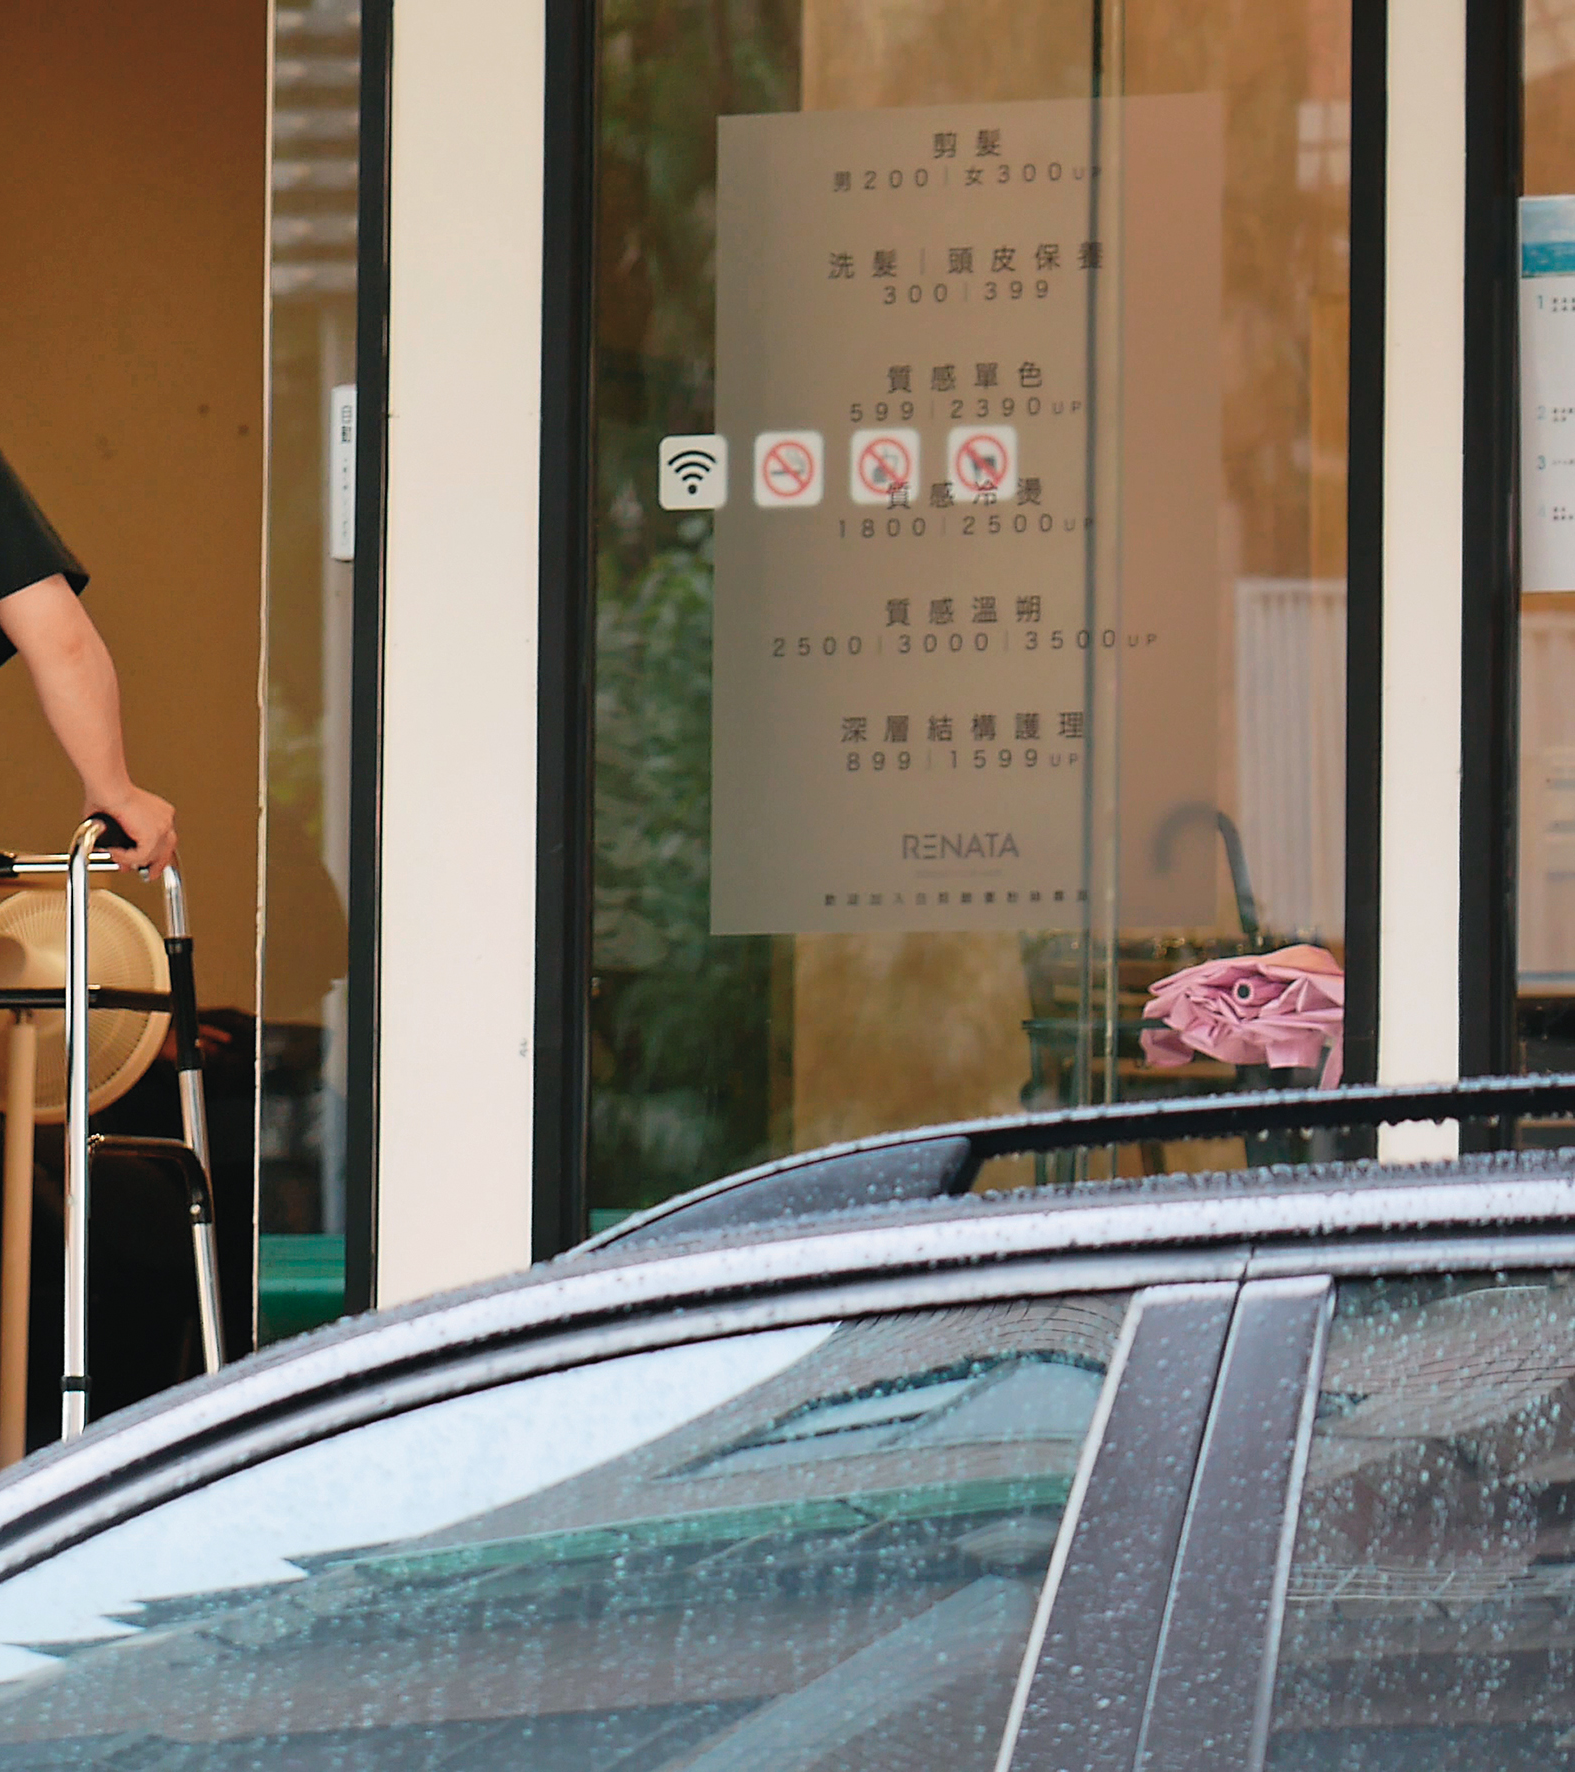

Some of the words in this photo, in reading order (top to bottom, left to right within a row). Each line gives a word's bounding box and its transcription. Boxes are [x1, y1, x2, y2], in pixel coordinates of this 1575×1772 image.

[933, 128, 1001, 159] 剪髮
[883, 283, 948, 305] 300
[985, 279, 1049, 301] 399
[887, 361, 1043, 394] 質感單色
[849, 402, 915, 423] 599
[886, 477, 1043, 510] 質感冷燙
[838, 517, 927, 539] 1800
[772, 635, 863, 658] 2500
[898, 633, 989, 654] 3000
[841, 710, 1084, 744] 深層結構護理
[846, 750, 912, 772] 899
[902, 832, 1020, 860] RENATA
